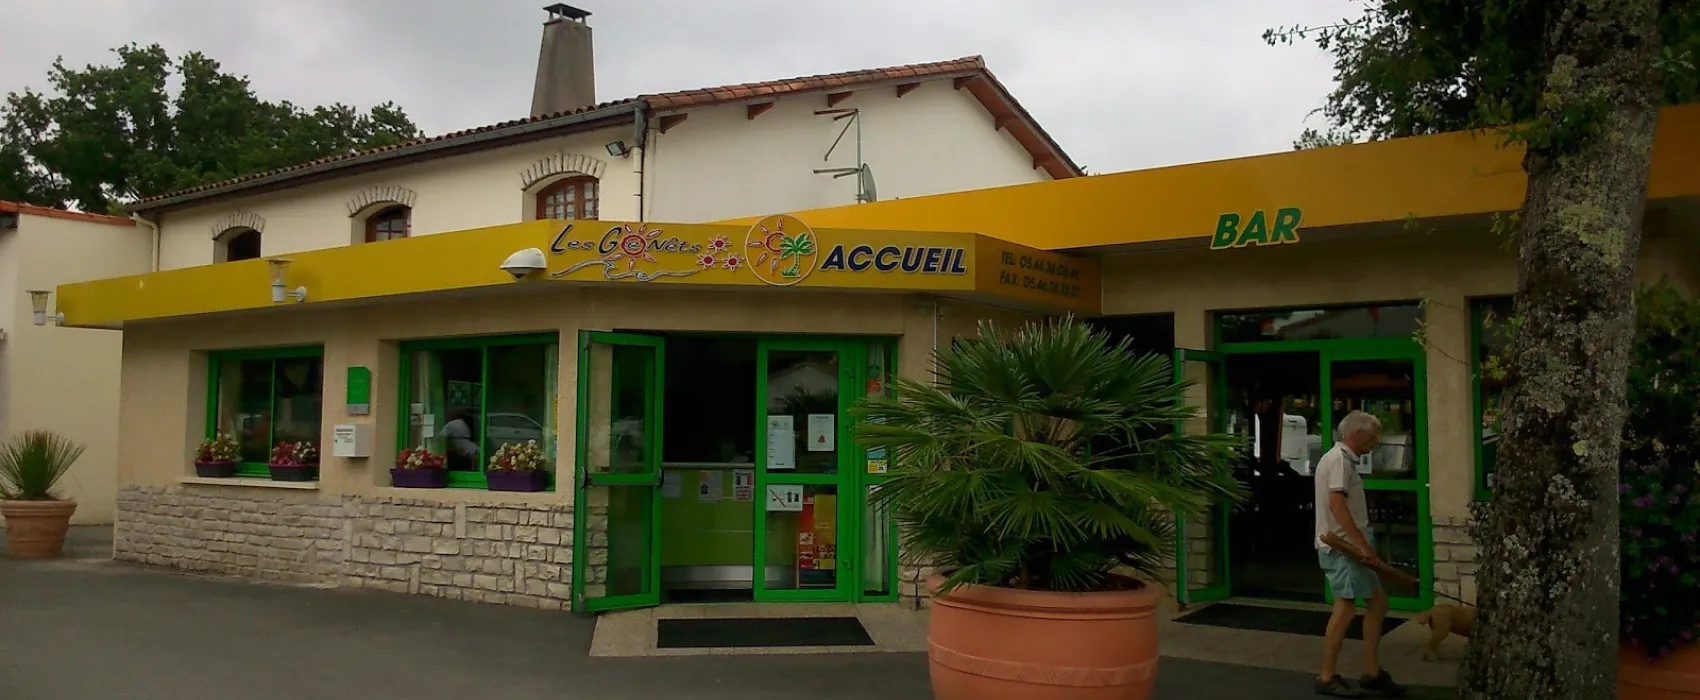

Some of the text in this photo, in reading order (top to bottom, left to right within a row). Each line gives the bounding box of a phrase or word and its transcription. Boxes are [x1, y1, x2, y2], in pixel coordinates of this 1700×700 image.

[550, 224, 596, 253] Les
[1210, 206, 1303, 249] BAR
[819, 244, 968, 275] ACCUEIL
